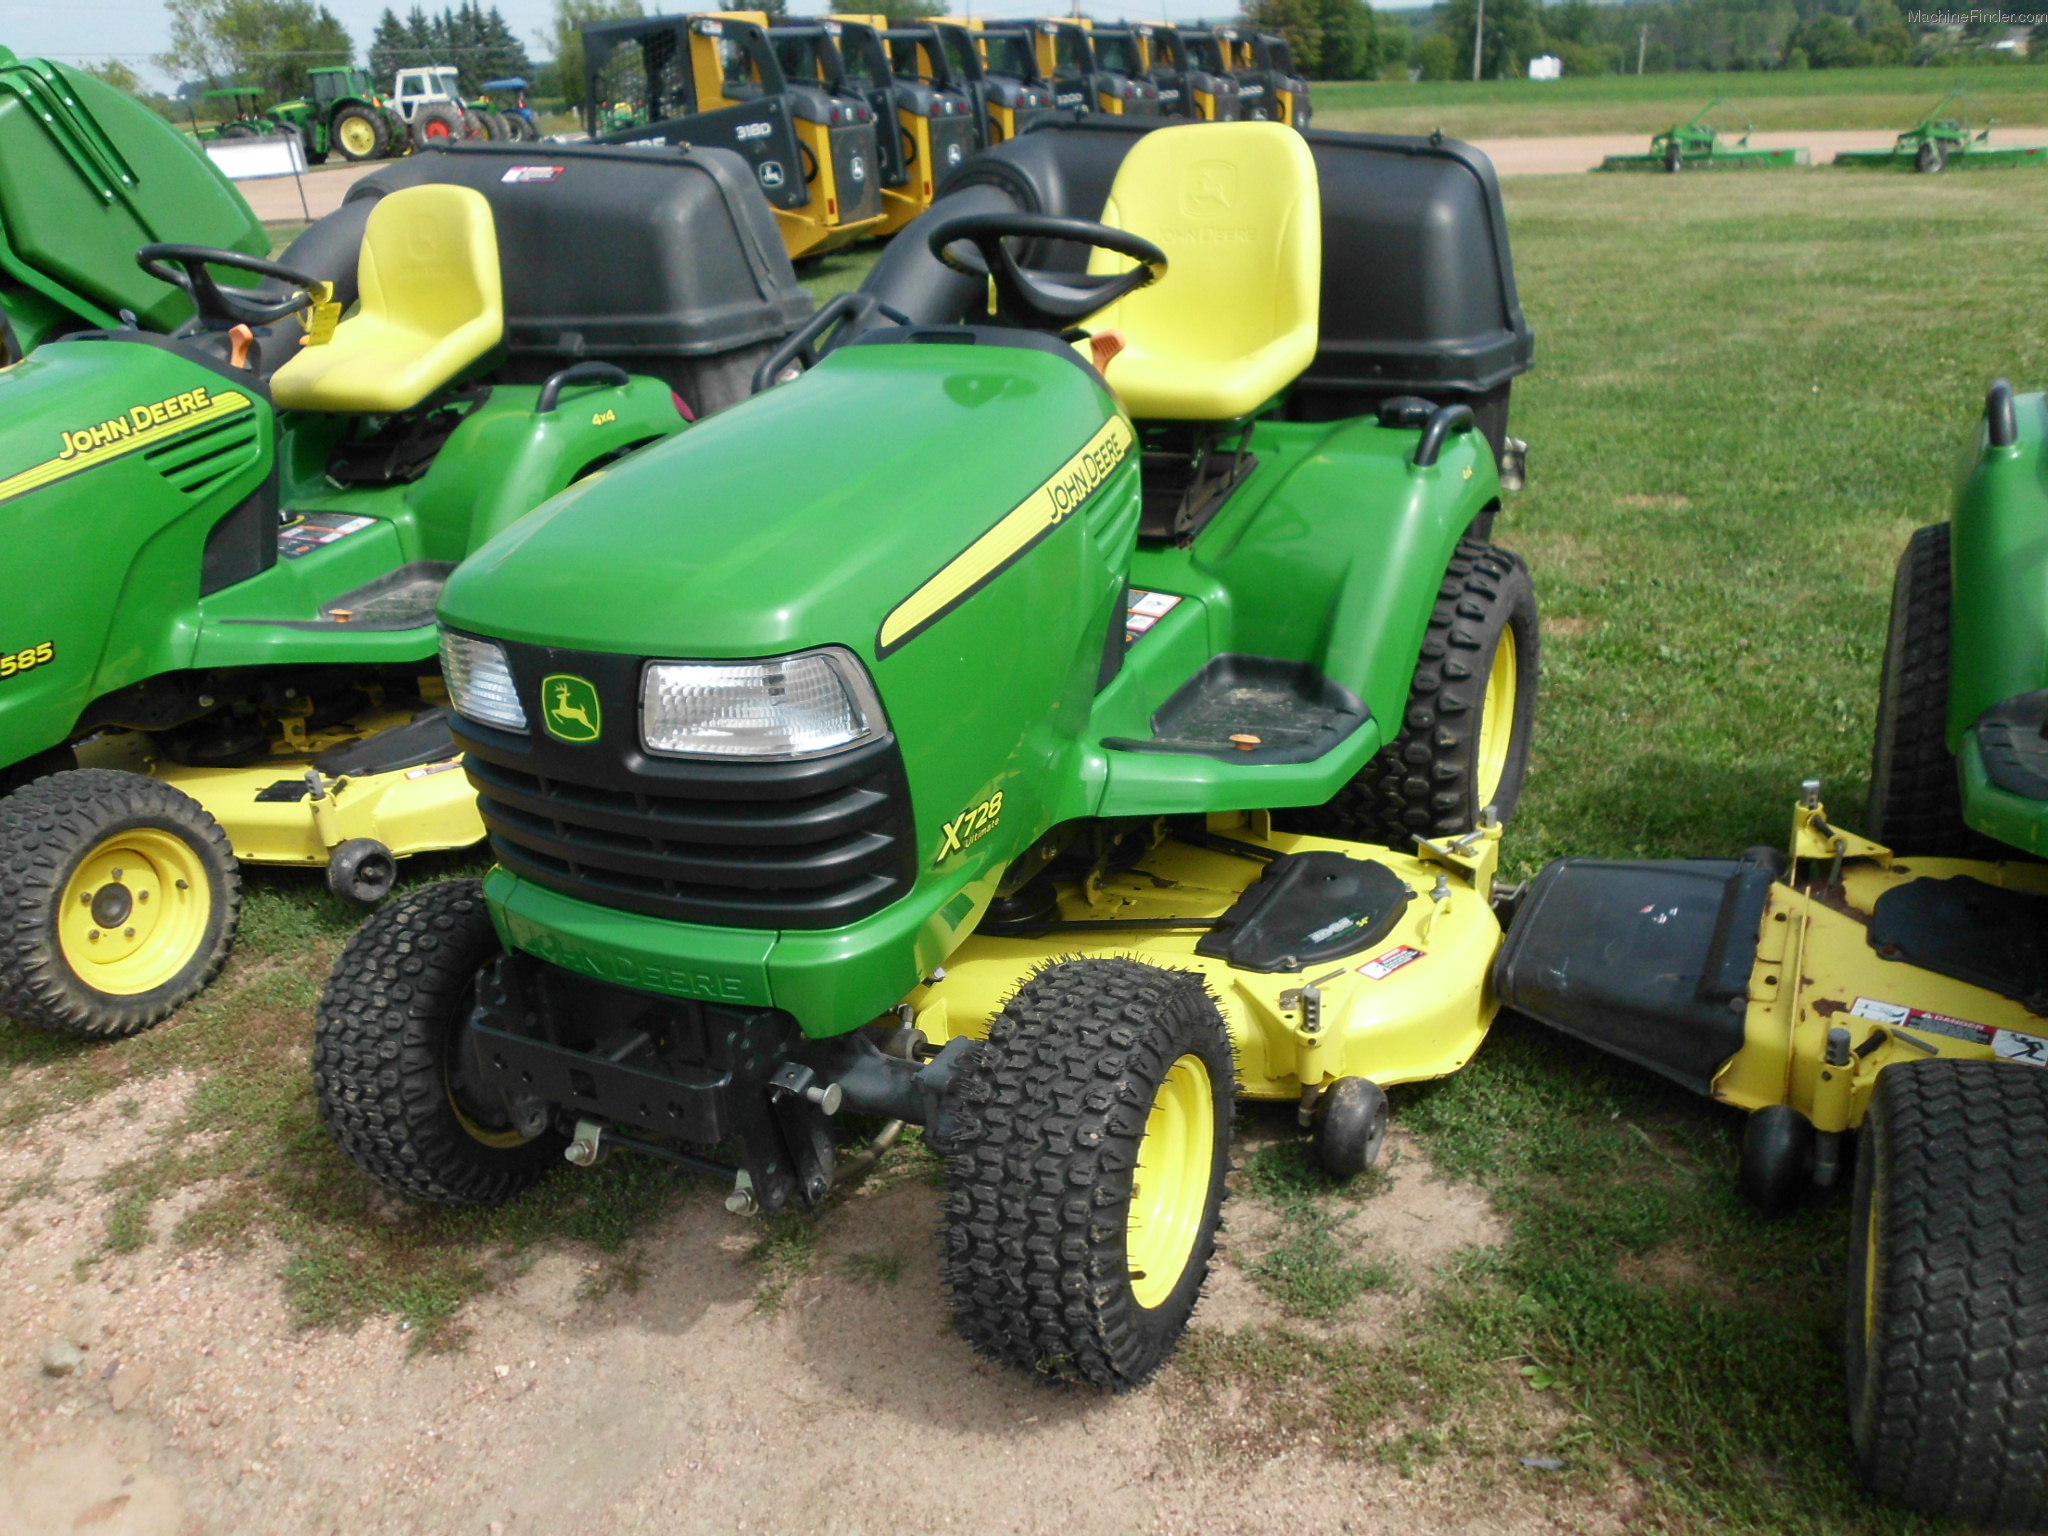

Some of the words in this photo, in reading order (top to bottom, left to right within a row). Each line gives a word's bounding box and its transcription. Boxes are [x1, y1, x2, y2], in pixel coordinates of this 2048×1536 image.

[59, 416, 131, 460] JOHN
[129, 386, 212, 432] DEERE
[1046, 467, 1089, 522] JOHN
[1082, 432, 1123, 483] DEERE
[936, 790, 1004, 863] X728
[609, 953, 746, 1000] DEERE
[1934, 1014, 1985, 1031] DANGER
